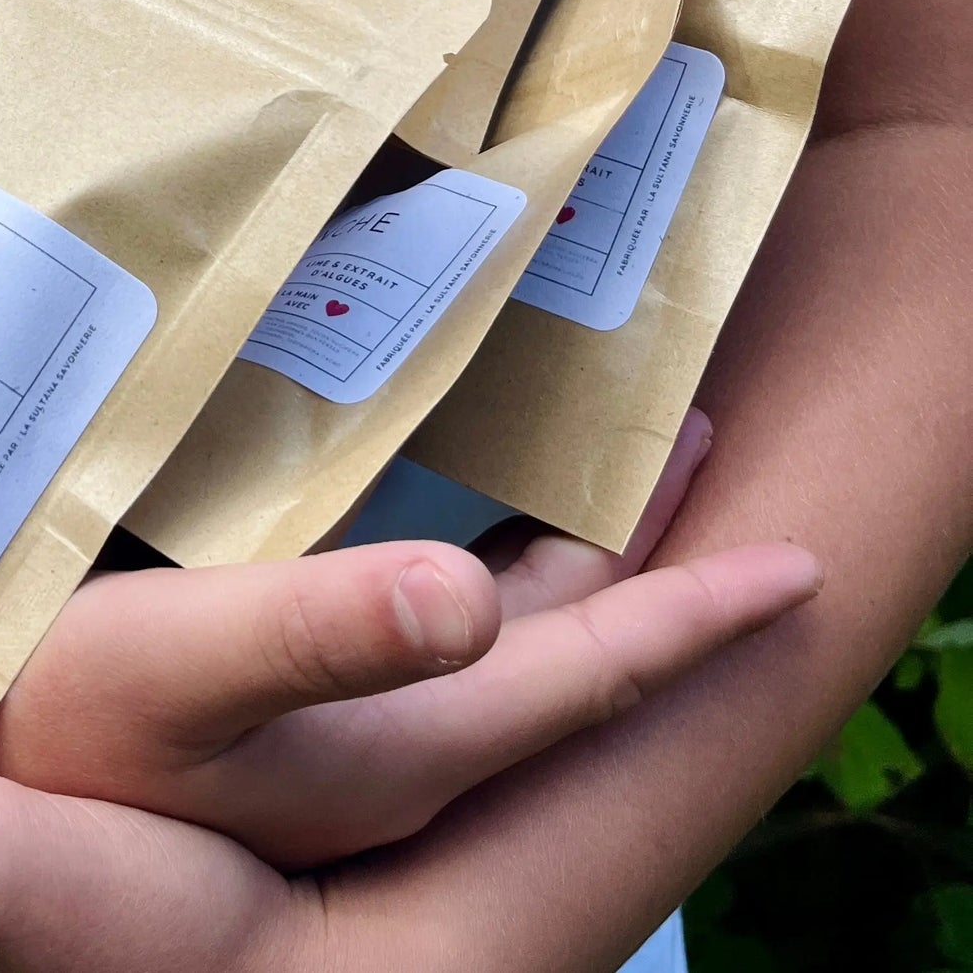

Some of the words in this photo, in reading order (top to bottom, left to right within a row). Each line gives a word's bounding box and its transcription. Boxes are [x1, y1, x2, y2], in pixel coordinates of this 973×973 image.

[648, 191, 656, 203] LA
[652, 149, 674, 190] SULTANA
[669, 95, 696, 148] SAVONNERIE
[306, 259, 331, 268] LIME
[343, 263, 398, 289] EXTRAIT
[310, 269, 368, 290] D'ALGUES
[425, 303, 436, 314] LA
[434, 272, 462, 303] SULTANA
[460, 228, 497, 271] SAVONNERIE
[284, 300, 310, 310] AVEC
[294, 290, 319, 300] MAIN
[19, 424, 30, 437] LA
[28, 382, 58, 422] SULTANA
[56, 323, 97, 381] SAVONNERIE
